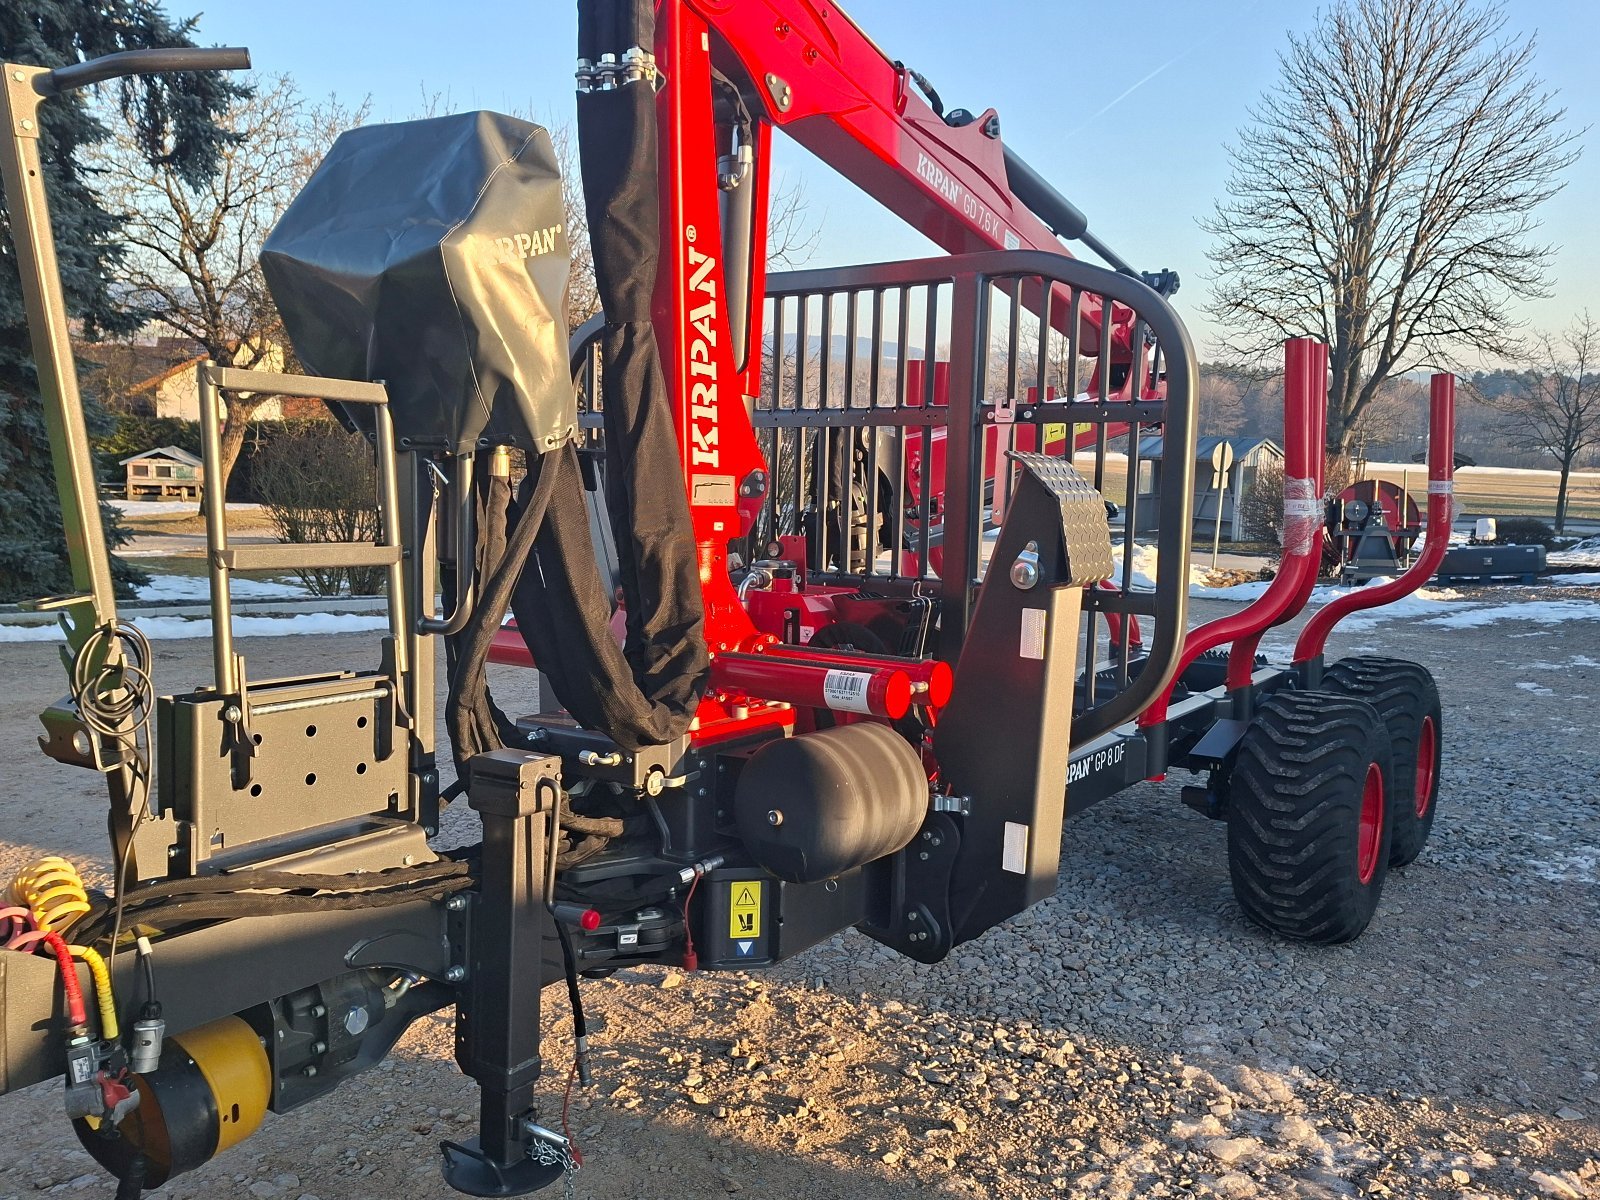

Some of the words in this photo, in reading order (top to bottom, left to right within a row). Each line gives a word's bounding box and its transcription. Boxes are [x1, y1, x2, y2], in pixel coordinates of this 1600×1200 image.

[963, 193, 977, 219] GD
[979, 205, 991, 232] 7,6
[992, 219, 999, 239] K
[1095, 750, 1107, 772] GP
[1107, 747, 1113, 766] 8
[1114, 742, 1126, 764] DF
